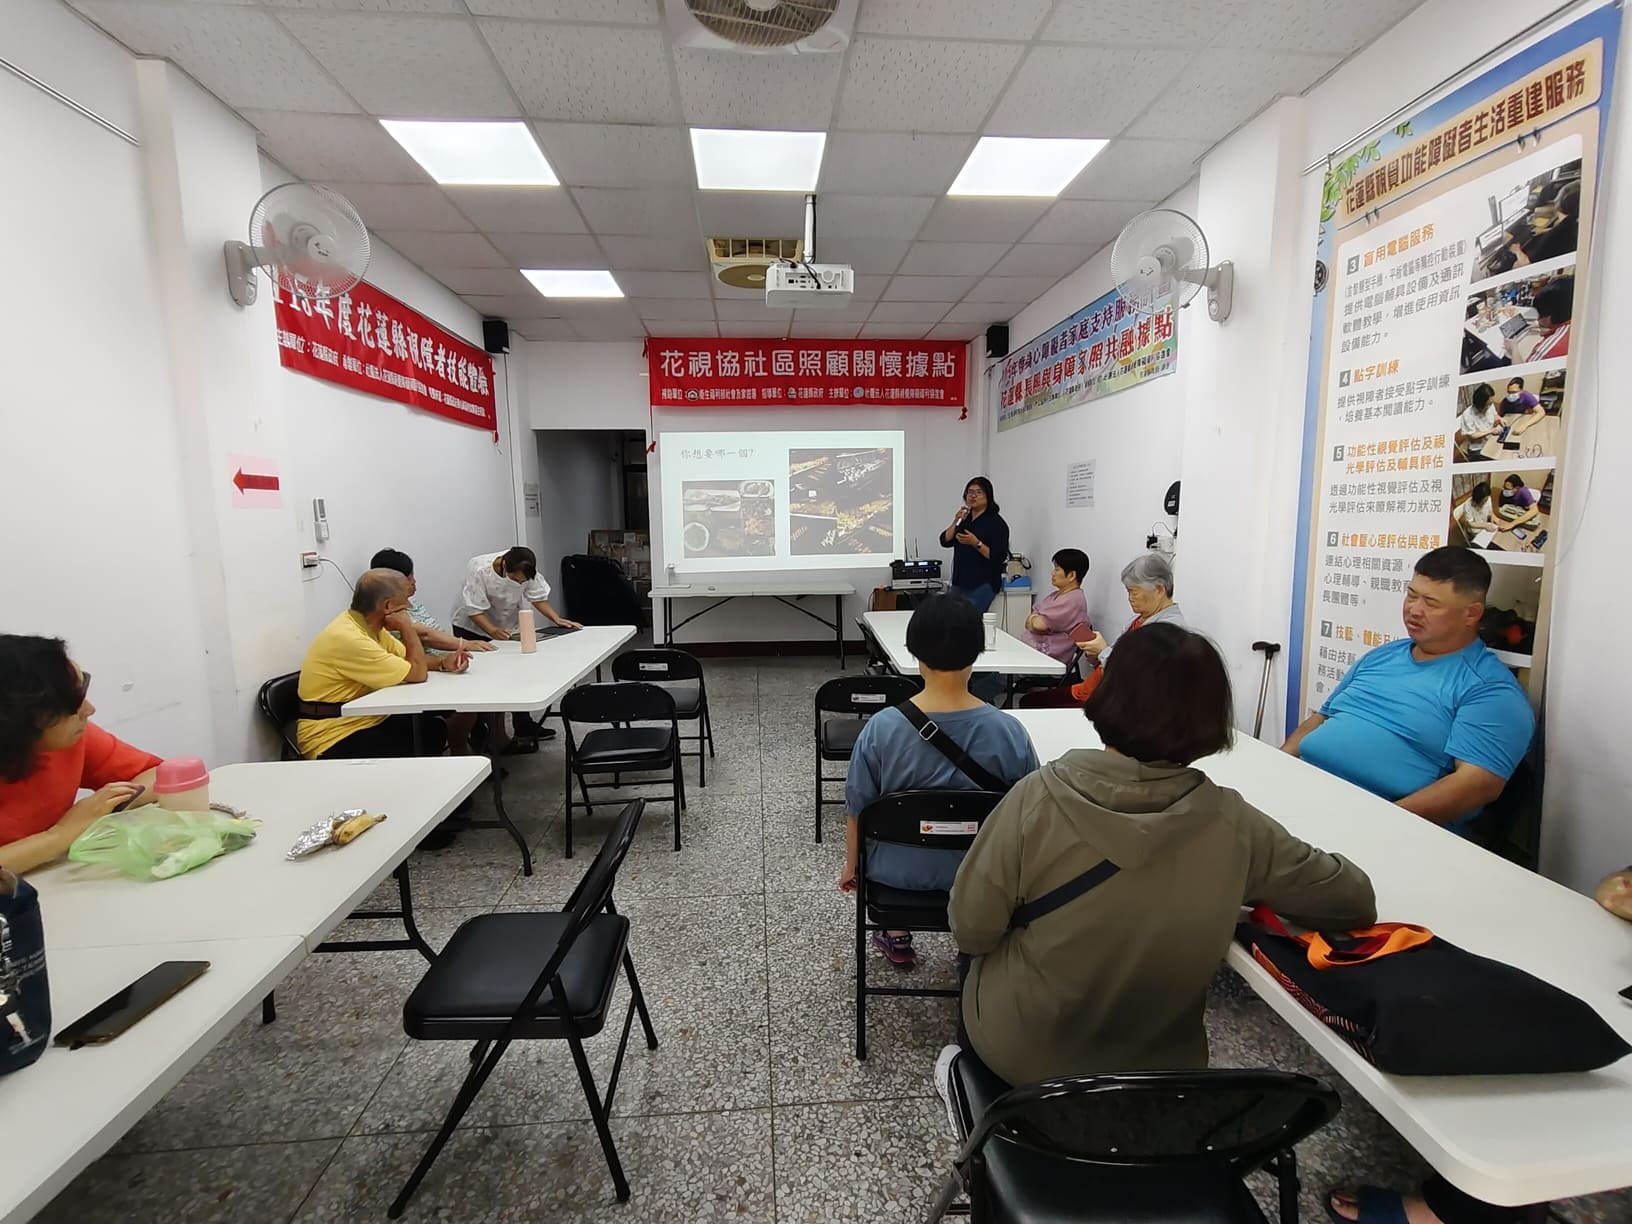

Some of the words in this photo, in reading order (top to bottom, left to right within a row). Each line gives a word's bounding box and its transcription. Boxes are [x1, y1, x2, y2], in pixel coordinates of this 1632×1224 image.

[1346, 59, 1585, 215] 花蓮縣視覺功能障礙者生活重建服務
[660, 350, 955, 378] 花視協社區照顧關懷據點
[1354, 359, 1400, 383] 點字訓練
[1336, 625, 1399, 647] 技藝、體能及
